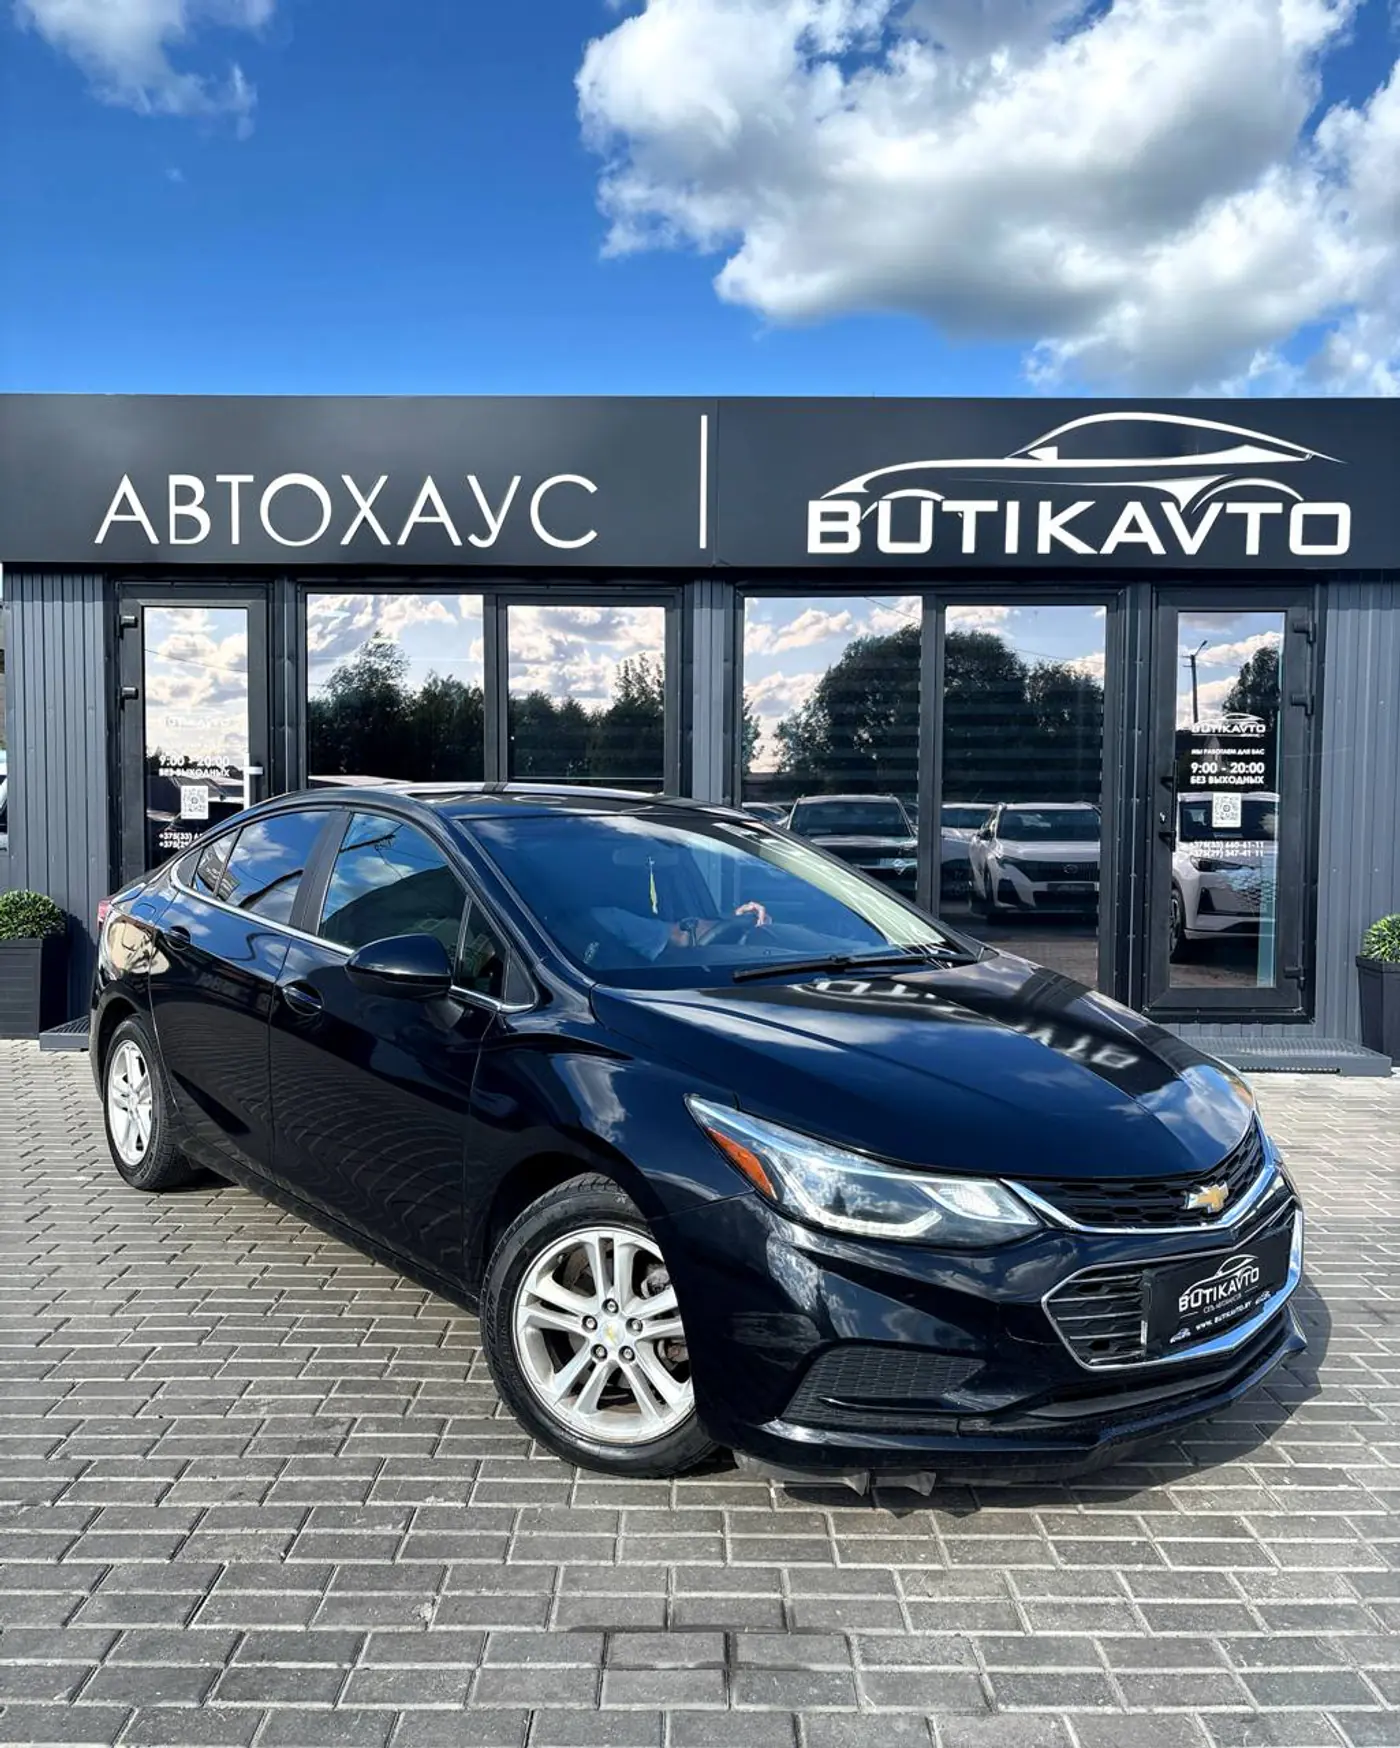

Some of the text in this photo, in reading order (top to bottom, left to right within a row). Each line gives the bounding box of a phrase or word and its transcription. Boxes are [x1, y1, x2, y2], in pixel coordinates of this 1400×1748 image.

[94, 472, 599, 549] АВТОХАУС
[806, 499, 1352, 557] BUTIKAVTO
[1190, 775, 1265, 785] БЕЗ ВЫХОДНЫХ
[1191, 762, 1218, 774] 9:00
[1230, 762, 1265, 774] 20:00
[1178, 1267, 1260, 1313] BUTIKAVTO
